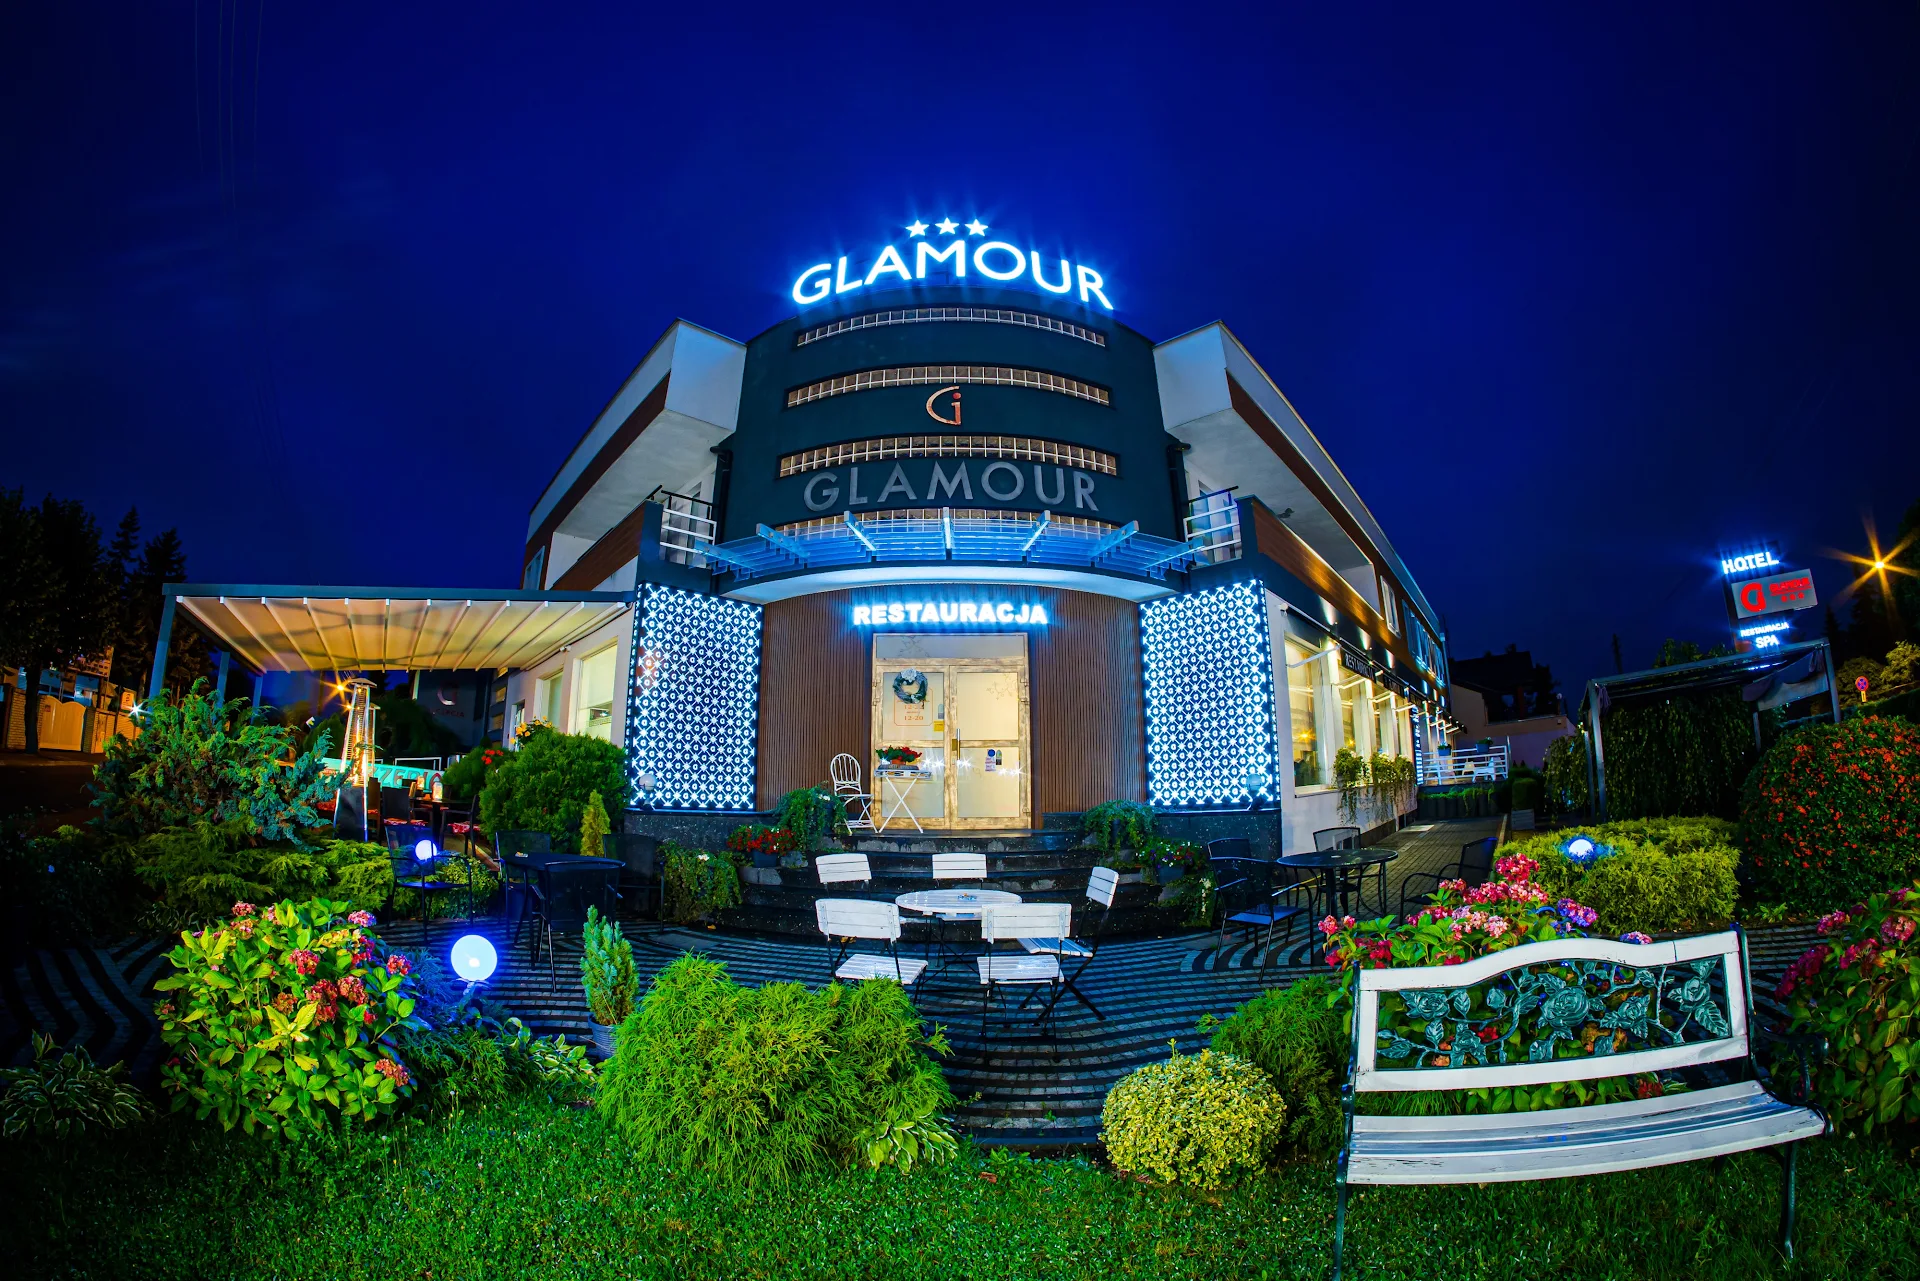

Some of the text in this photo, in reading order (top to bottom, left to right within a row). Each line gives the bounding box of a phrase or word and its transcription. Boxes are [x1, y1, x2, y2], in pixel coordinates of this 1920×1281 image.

[792, 240, 1113, 310] GLAMOUR
[803, 461, 1099, 512] GLAMOUR
[1721, 551, 1780, 575] HOTEL
[853, 602, 1048, 625] RESTAURACJA
[1740, 621, 1790, 637] RESTAURACJA
[1755, 634, 1780, 649] SPA
